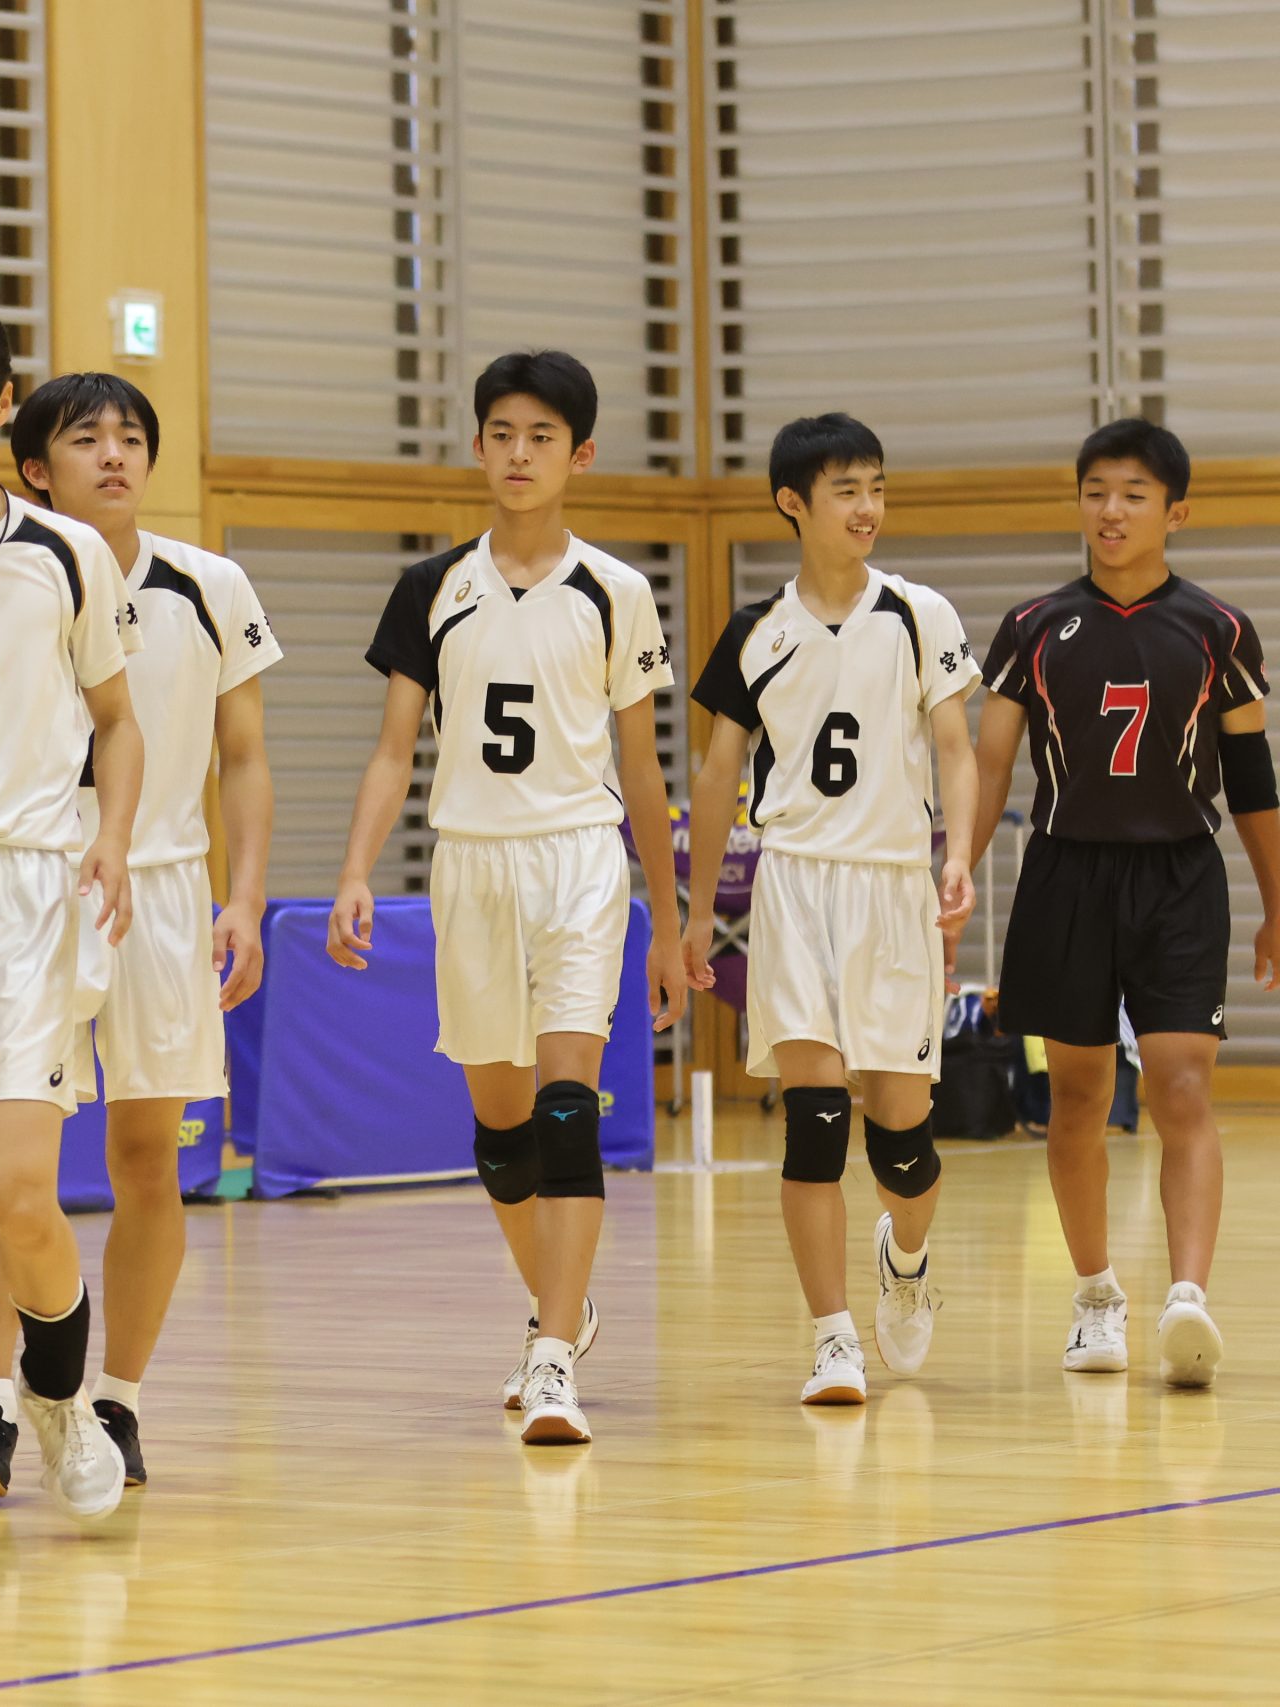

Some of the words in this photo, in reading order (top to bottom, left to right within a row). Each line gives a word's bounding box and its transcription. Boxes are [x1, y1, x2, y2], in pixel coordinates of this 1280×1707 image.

[244, 616, 272, 648] 宮
[482, 682, 536, 775] 5
[810, 711, 860, 798] 6
[1100, 680, 1150, 776] 7
[177, 1120, 206, 1147] SP
